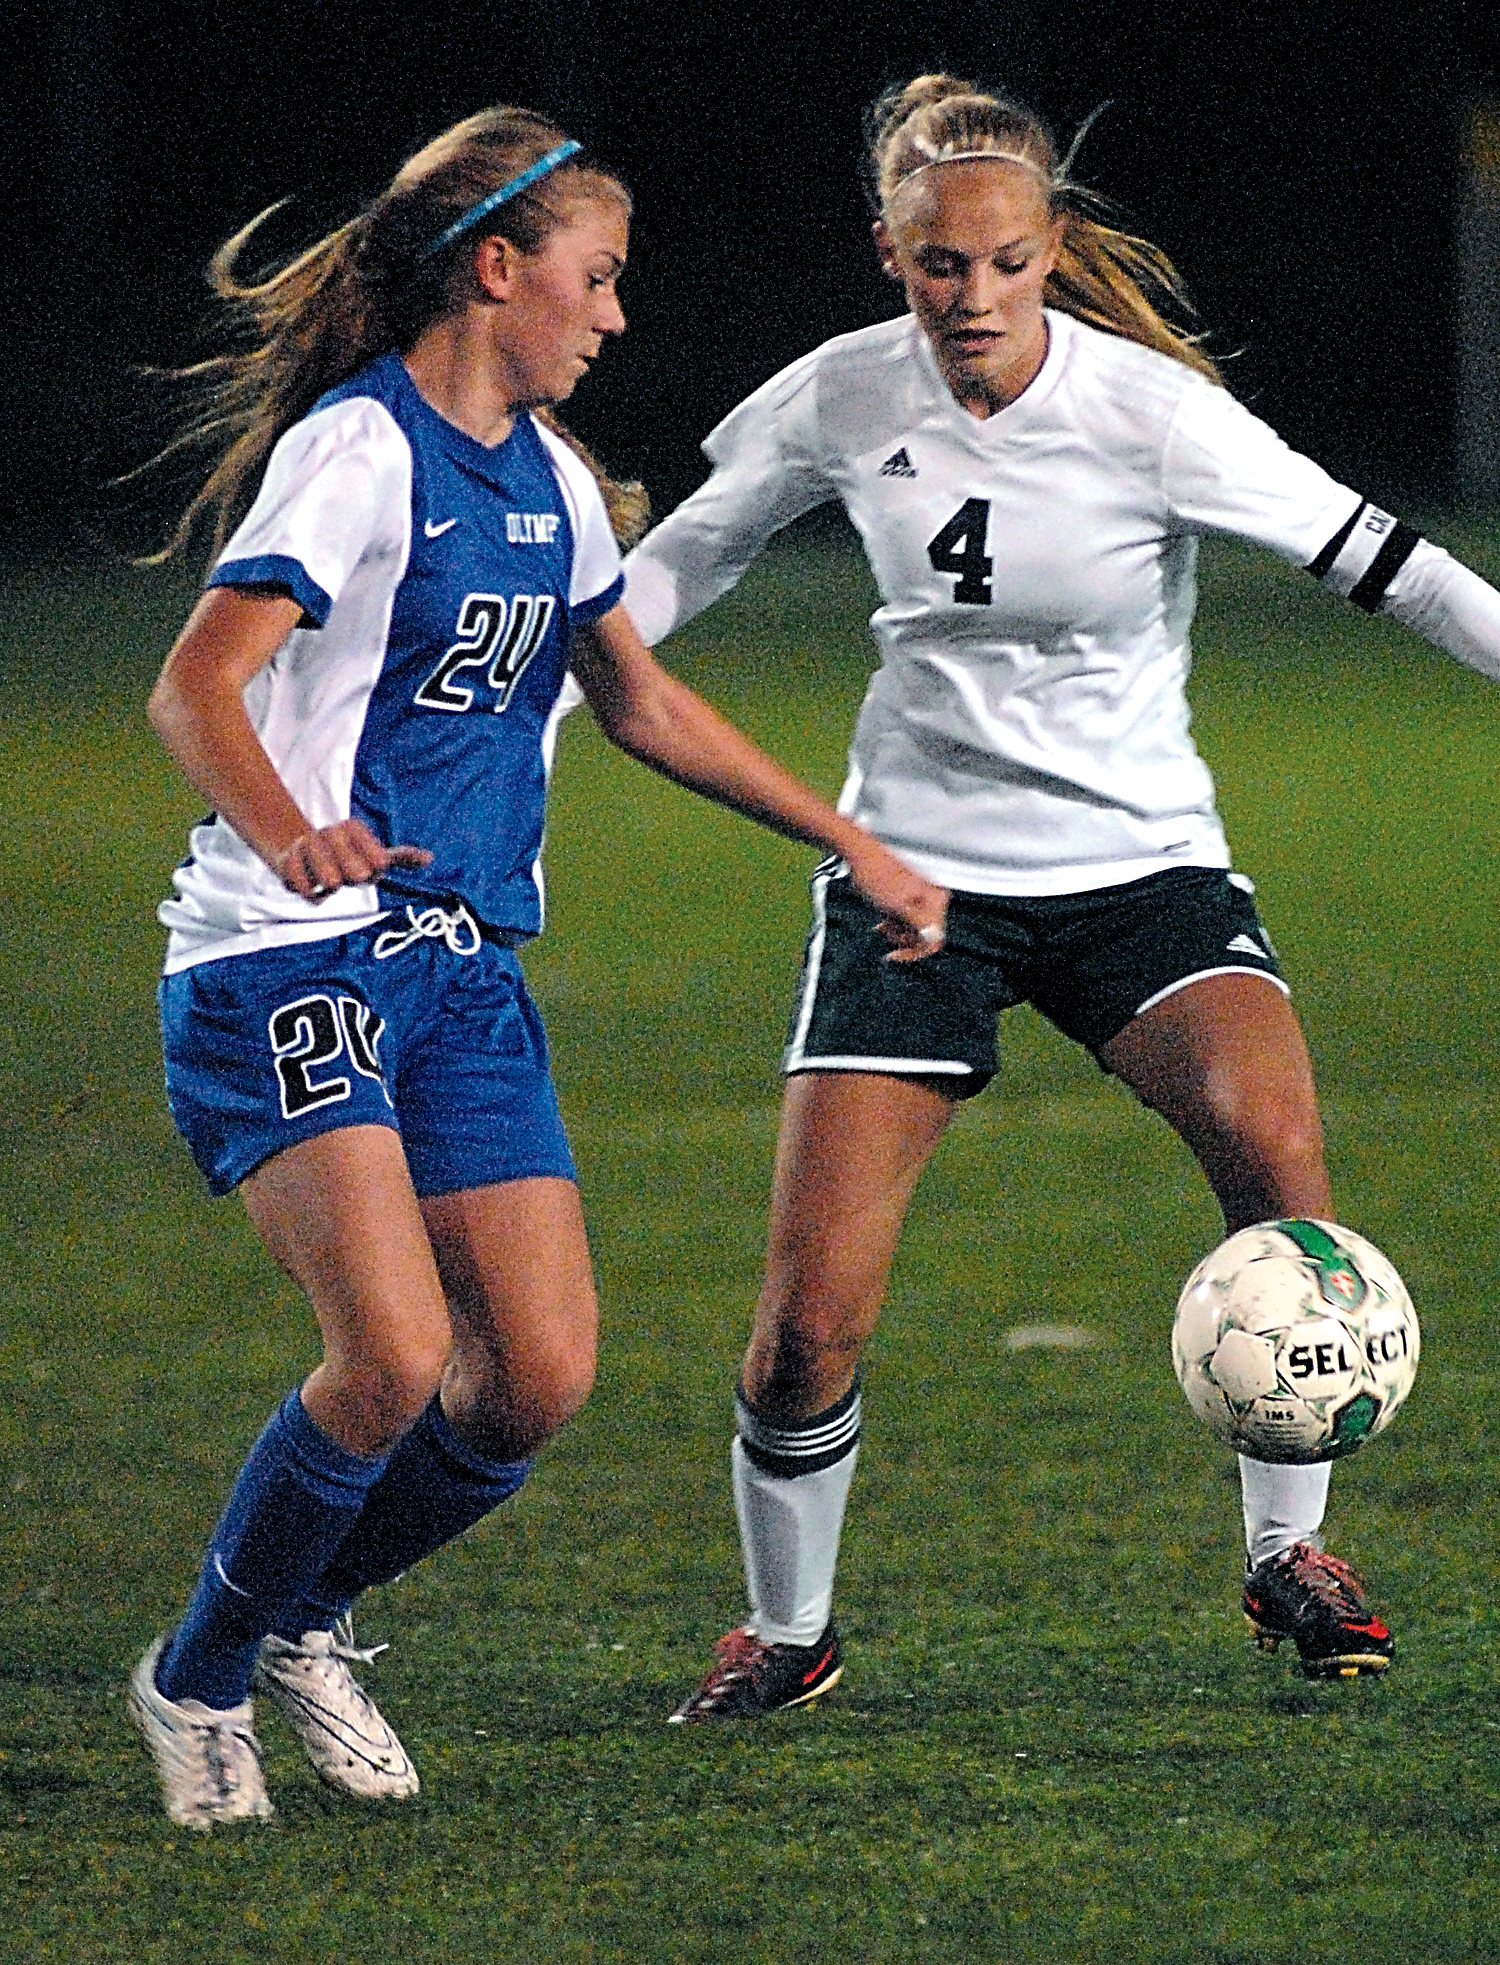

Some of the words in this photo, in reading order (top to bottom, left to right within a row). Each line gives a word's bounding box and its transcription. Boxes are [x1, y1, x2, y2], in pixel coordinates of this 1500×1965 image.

[927, 496, 993, 605] 4
[413, 593, 555, 712] 24
[1288, 1324, 1408, 1379] SELECT
